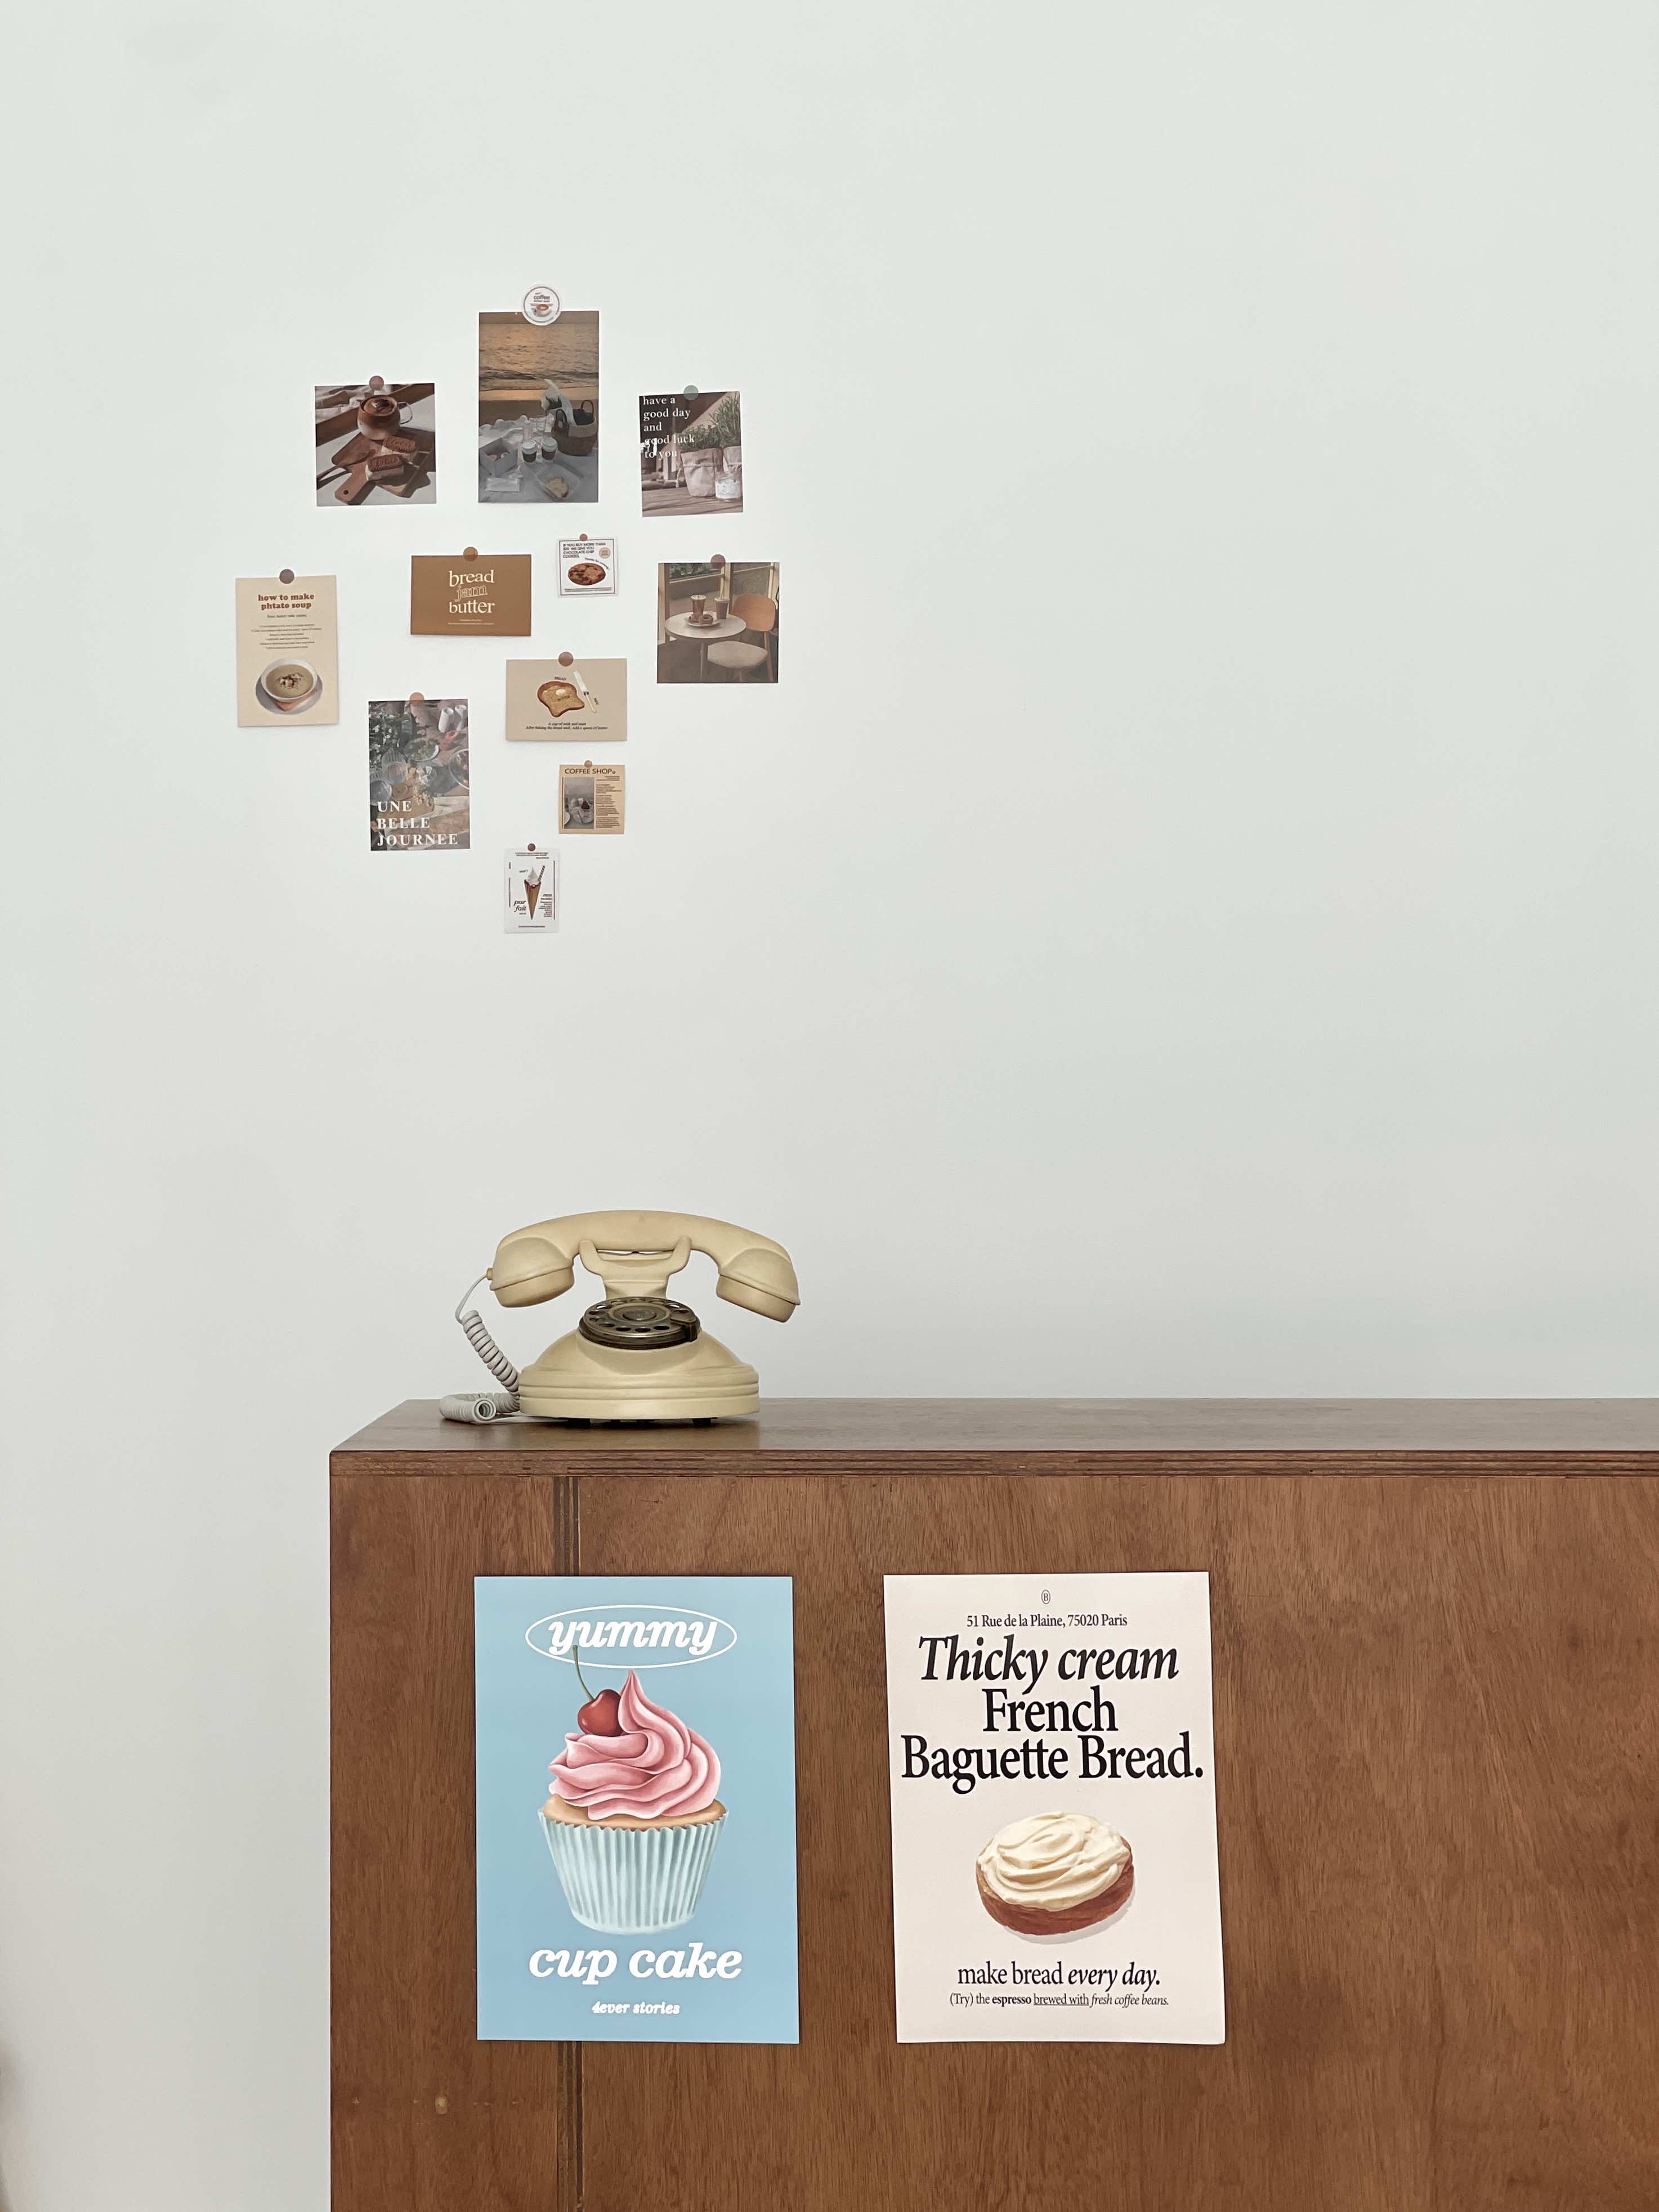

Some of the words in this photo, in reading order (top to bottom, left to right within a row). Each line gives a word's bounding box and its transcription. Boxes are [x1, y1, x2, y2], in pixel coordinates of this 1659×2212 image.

[643, 396, 667, 405] have
[643, 409, 669, 421] good
[673, 408, 691, 420] day
[643, 422, 662, 432] and
[645, 435, 669, 447] good
[673, 434, 695, 444] luck
[659, 450, 677, 460] you
[448, 570, 495, 586] bread
[454, 585, 488, 602] jam
[449, 599, 495, 614] butter
[377, 800, 412, 812] UNE
[377, 817, 430, 830] BELLE
[967, 1615, 978, 1627] 51
[982, 1615, 1002, 1627] Rue
[1004, 1614, 1017, 1627] de
[1018, 1614, 1029, 1627] la
[1030, 1614, 1066, 1628] Plaine,
[1067, 1614, 1099, 1627] 75020
[1101, 1613, 1128, 1626] Paris
[548, 1620, 717, 1656] yummy
[918, 1633, 1049, 1695] Thicky
[1058, 1646, 1179, 1680] cream
[981, 1685, 1119, 1732] French
[901, 1734, 1069, 1794] Baguette
[1077, 1731, 1204, 1779] Bread.
[529, 1948, 618, 1985] cup
[629, 1942, 743, 1980] cake
[957, 1960, 1008, 1986] make
[1010, 1961, 1063, 1985] bread
[1068, 1967, 1117, 1992] every
[1121, 1962, 1160, 1992] day.
[592, 2001, 629, 2014] 4ever
[633, 2001, 680, 2014] stories
[950, 1992, 974, 2008] (Try)
[976, 1992, 990, 2004] the
[992, 1995, 1031, 2007] espresso
[1034, 1993, 1067, 2005] brewed
[1069, 1993, 1089, 2005] with
[1089, 1993, 1112, 2008] fresh
[1115, 1994, 1139, 2008] coffee
[1142, 1994, 1169, 2005] beans.
